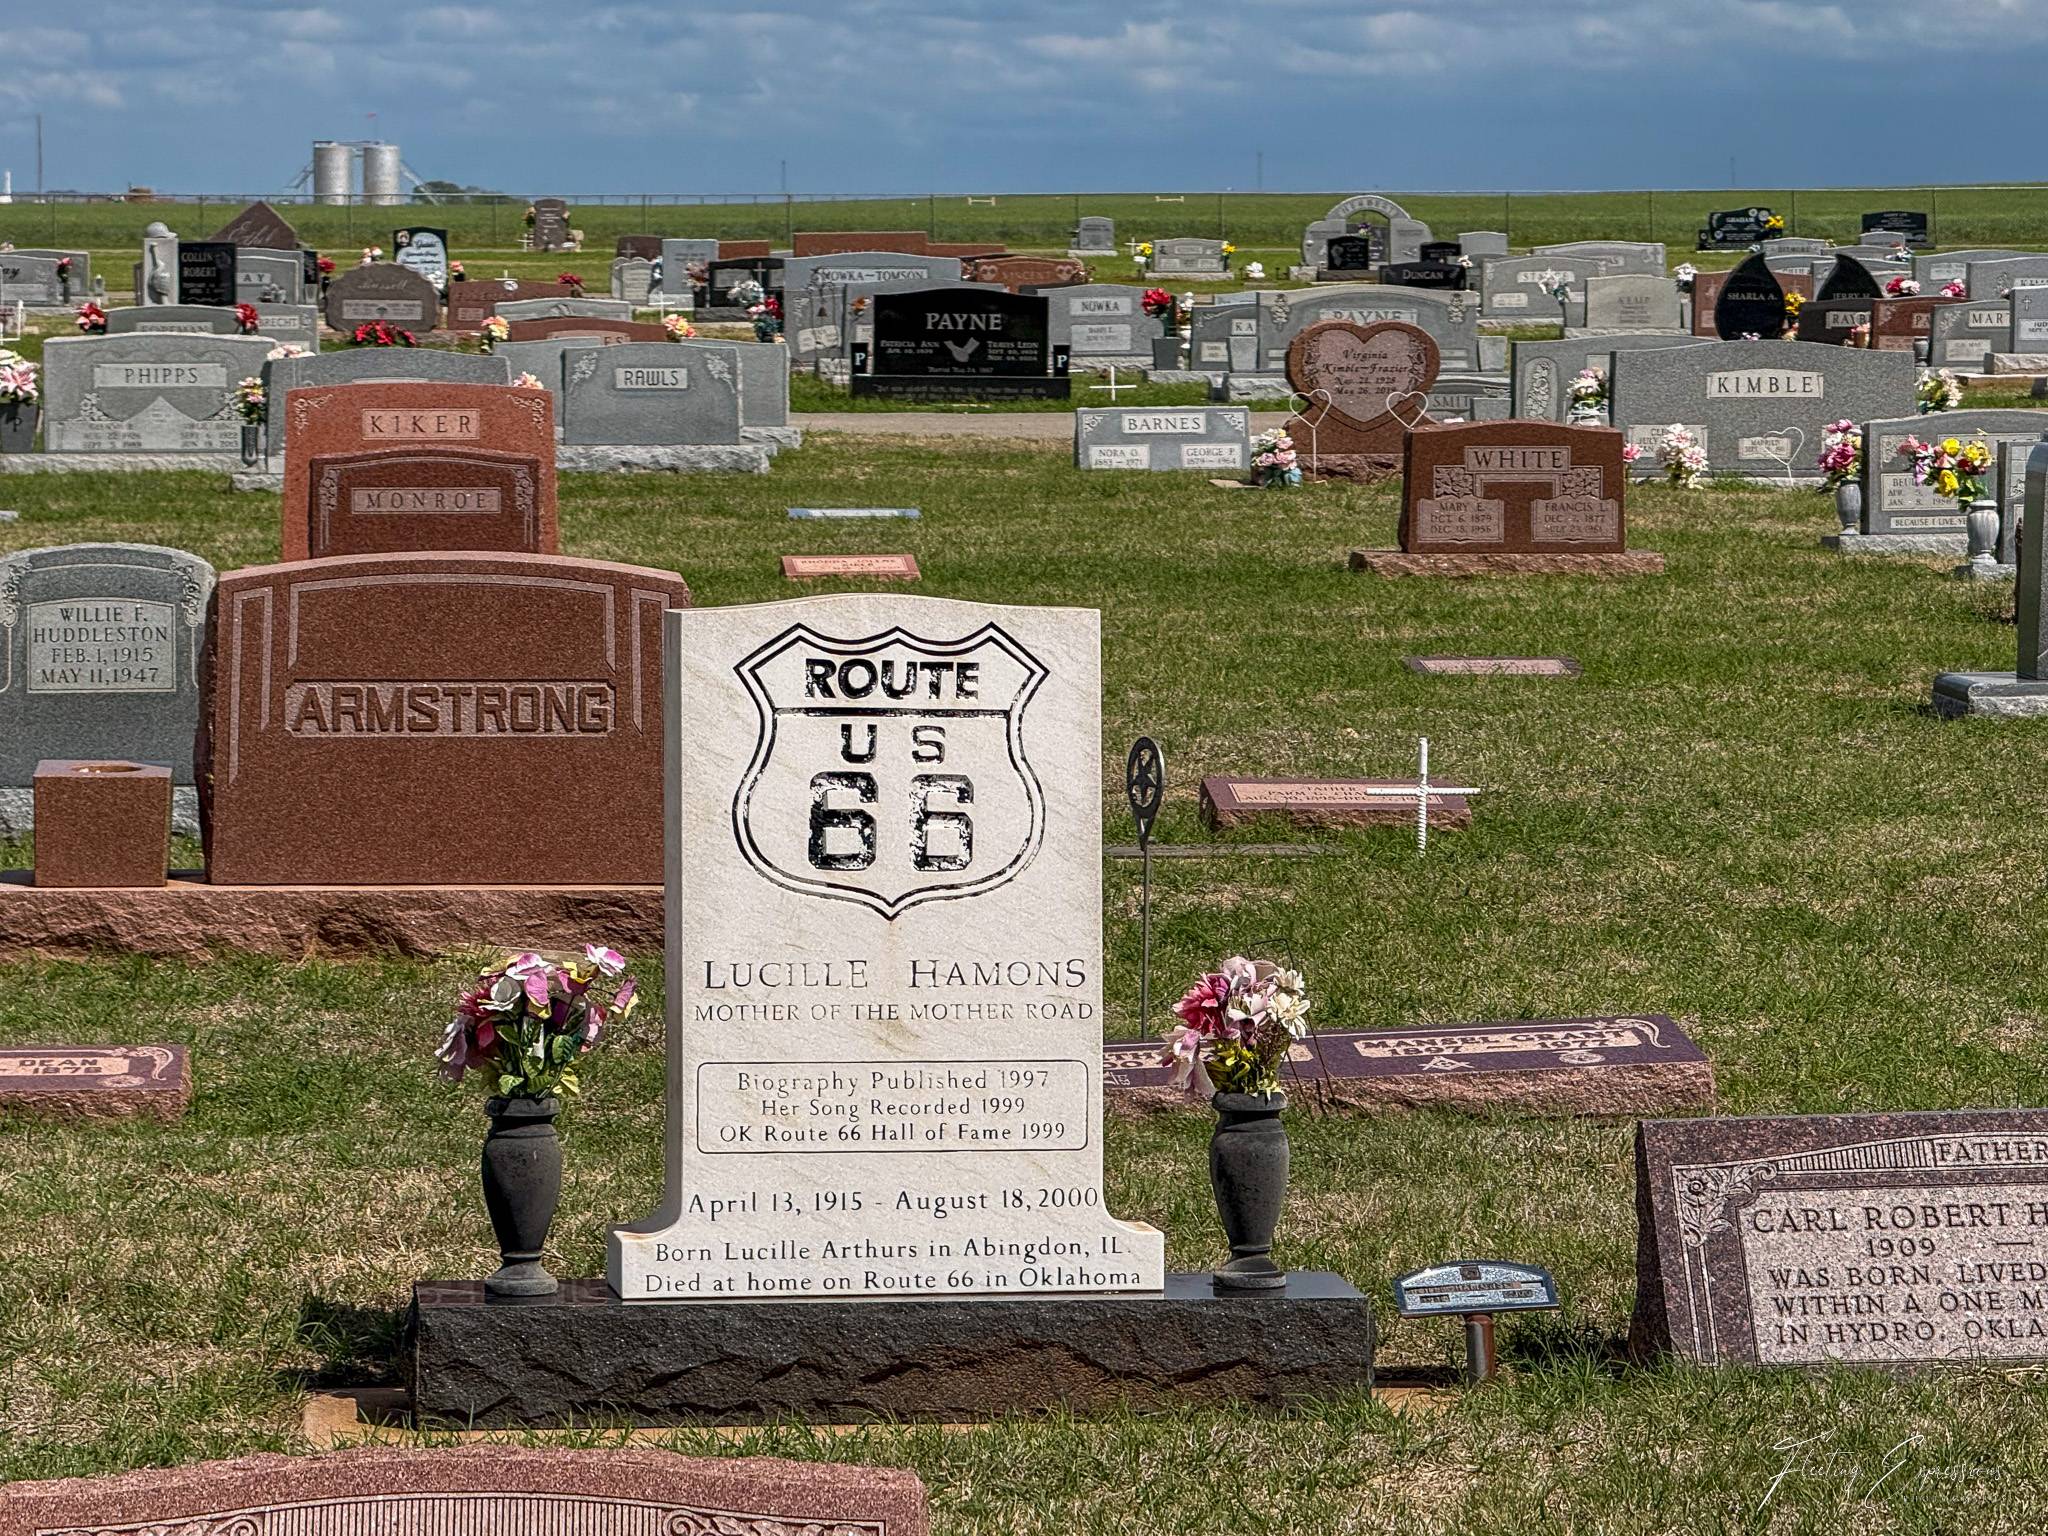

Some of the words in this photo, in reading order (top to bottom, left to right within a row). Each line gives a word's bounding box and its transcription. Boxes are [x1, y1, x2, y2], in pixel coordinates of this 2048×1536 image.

[1402, 269, 1444, 280] DUNCAN
[1728, 291, 1765, 301] SHARLA
[1080, 300, 1121, 312] NOWKA
[926, 312, 1003, 331] PAYNE
[855, 352, 866, 366] P
[1057, 354, 1068, 368] P
[1342, 349, 1388, 362] Virginia
[124, 368, 199, 384] PHIPPS
[624, 370, 679, 386] RAWLS
[1717, 376, 1813, 393] KIMBLE
[370, 415, 472, 433] KIKER
[1128, 417, 1202, 431] BARNES
[1098, 449, 1126, 457] NORA
[1186, 448, 1223, 457] GEORGE
[1473, 450, 1564, 469] WHITE
[366, 492, 488, 509] MONROE
[1438, 502, 1469, 512] MARY
[1544, 501, 1594, 513] FRANCIS
[1895, 518, 1930, 527] BECAUSE
[59, 607, 123, 622] WILLIE
[134, 607, 148, 622] F.
[34, 626, 168, 643] HUDDLESTON
[52, 648, 91, 663] FEB.
[42, 668, 81, 683] MAY
[805, 658, 980, 700] ROUTE
[291, 684, 610, 734] ARMSTRONG
[704, 959, 869, 990] LUCILLE
[909, 958, 1087, 989] HAMONS
[694, 1004, 800, 1022] MOTHER
[810, 1004, 839, 1021] OF
[850, 1003, 900, 1021] THE
[910, 1003, 1014, 1020] MOTHER
[1026, 1002, 1094, 1020] ROAD
[1362, 1034, 1501, 1049] MANSEL
[1509, 1028, 1628, 1043] GRANT
[18, 1059, 99, 1067] DEAN
[737, 1071, 859, 1098] Biography
[871, 1069, 988, 1091] Published
[1001, 1069, 1050, 1089] 1997
[761, 1099, 800, 1117] Her
[809, 1099, 860, 1122] Song
[870, 1097, 971, 1116] Recorded
[981, 1097, 1026, 1114] 1999
[720, 1126, 753, 1143] OK
[764, 1125, 829, 1143] Route
[838, 1124, 862, 1142] 66
[871, 1123, 914, 1142] Hall
[924, 1122, 949, 1141] of
[957, 1124, 1012, 1140] Fame
[1021, 1122, 1066, 1140] 1999
[1937, 1140, 2048, 1163] FATHER
[688, 1191, 758, 1221] April
[771, 1192, 802, 1216] 13,
[814, 1191, 863, 1212] 1915
[895, 1190, 988, 1219] August
[1752, 1206, 1849, 1234] CARL
[1864, 1202, 2010, 1231] ROBERT
[655, 1242, 713, 1263] Born
[724, 1240, 811, 1262] Lucille
[821, 1239, 918, 1261] Arthurs
[928, 1238, 952, 1259] in
[963, 1236, 1091, 1265] Abingdon,
[1866, 1237, 1937, 1258] 1909
[644, 1272, 702, 1294] Died
[712, 1275, 736, 1293] at
[747, 1271, 813, 1292] home
[823, 1275, 852, 1291] on
[863, 1270, 936, 1290] Route
[946, 1268, 975, 1289] 66
[984, 1268, 1009, 1288] in
[1018, 1264, 1142, 1289] Oklahoma
[1769, 1267, 1831, 1289] WAS
[1959, 1261, 2048, 1284] LIVED
[1775, 1294, 1884, 1317] WITHIN
[1905, 1293, 1924, 1314] A
[1938, 1290, 2002, 1313] ONE
[1776, 1323, 1808, 1346] IN
